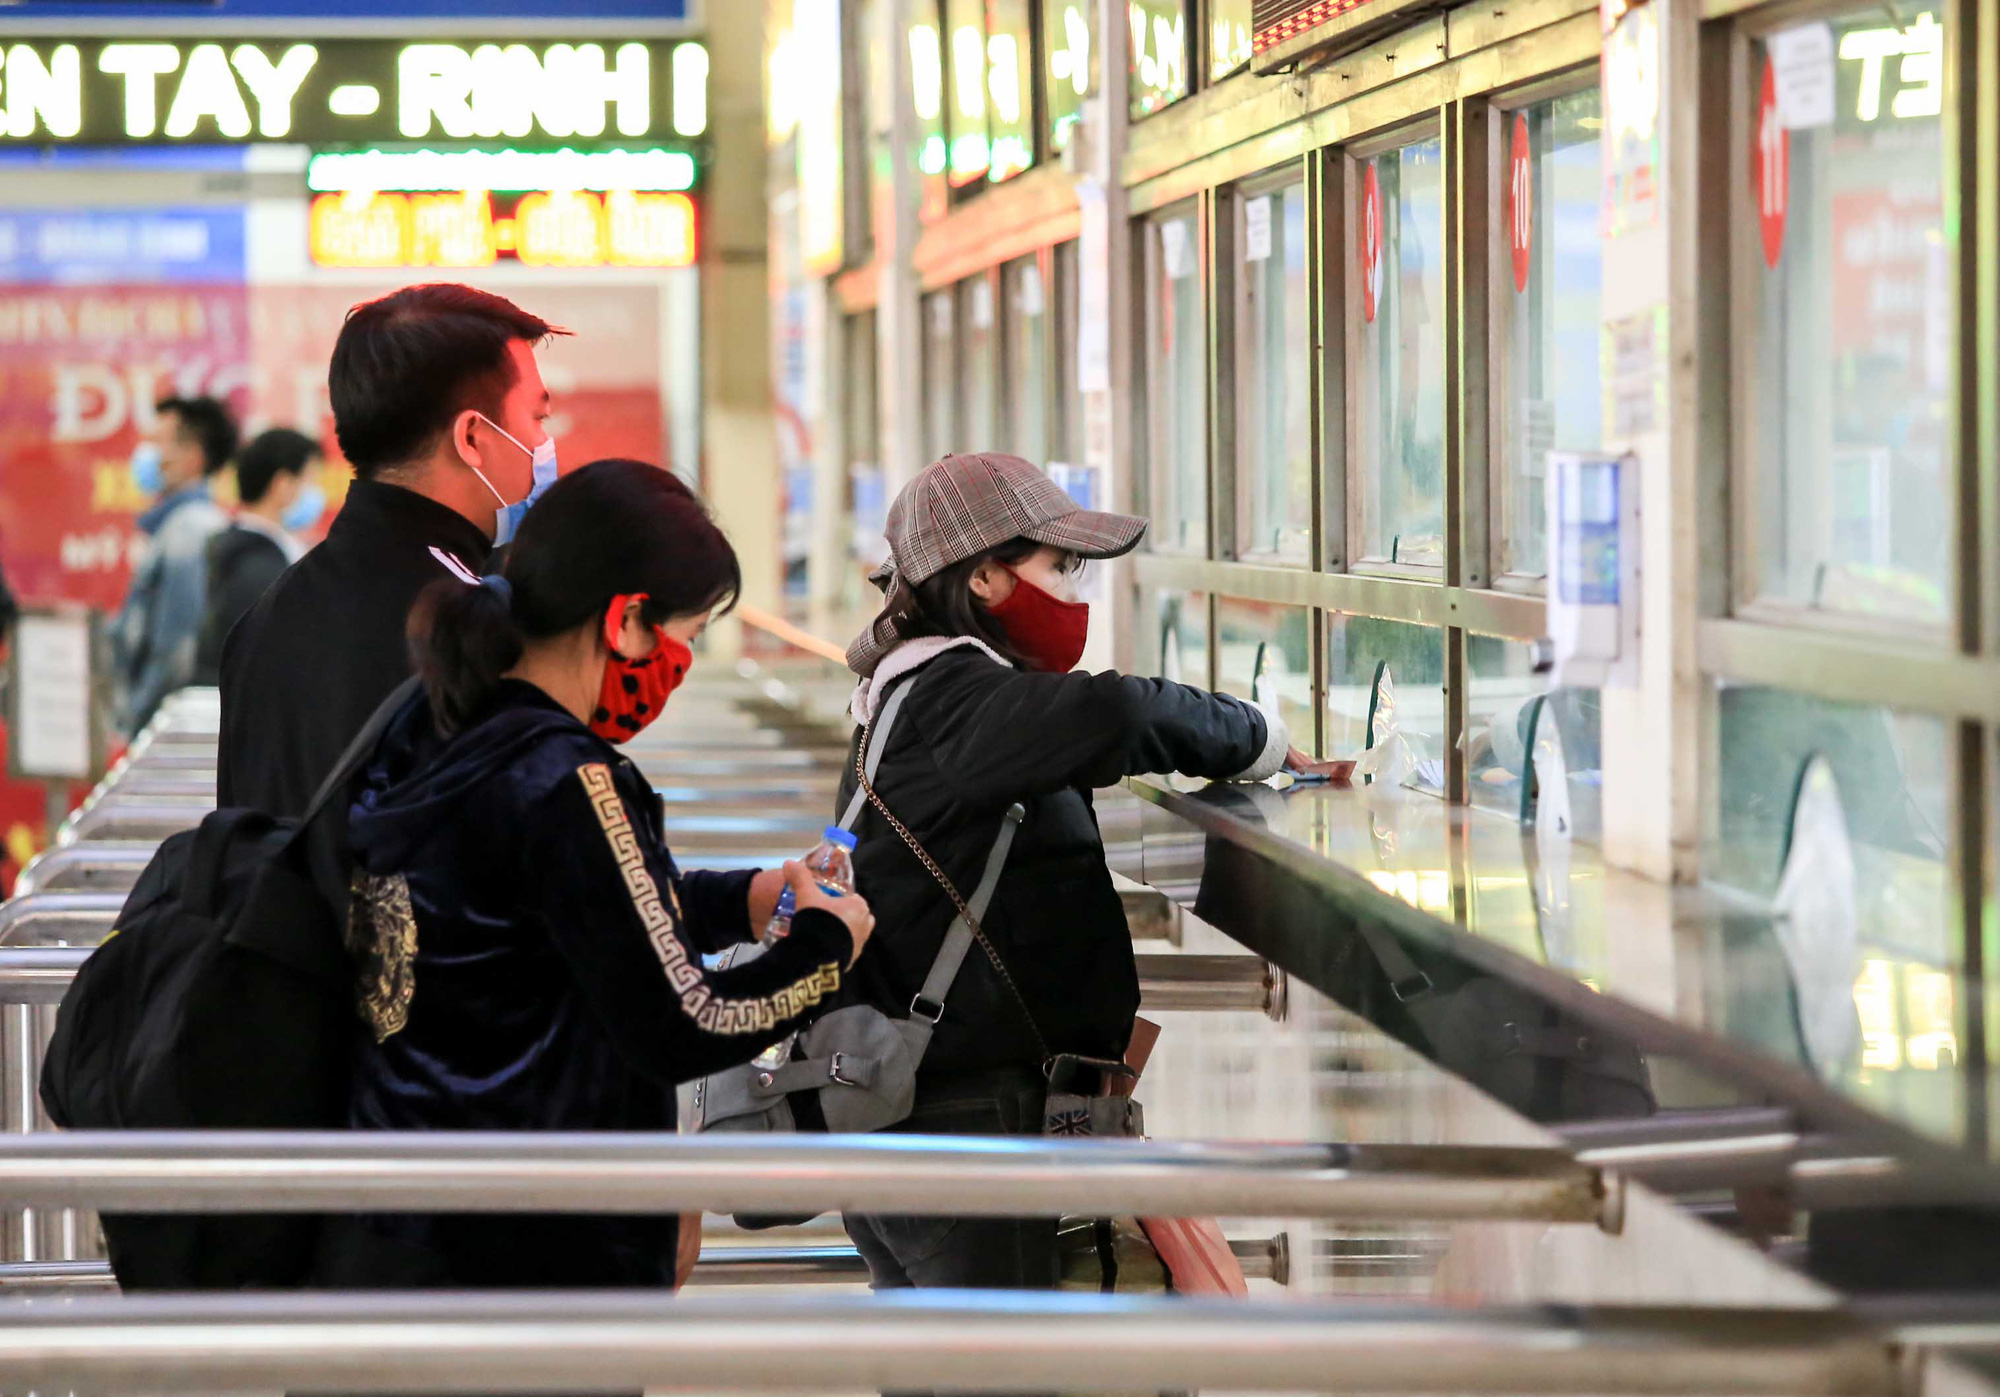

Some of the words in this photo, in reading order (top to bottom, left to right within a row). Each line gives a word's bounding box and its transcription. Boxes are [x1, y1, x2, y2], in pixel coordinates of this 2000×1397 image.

[98, 44, 317, 137] TAY
[1512, 157, 1528, 249] 10
[1760, 103, 1784, 217] 11
[1366, 194, 1375, 293] 9
